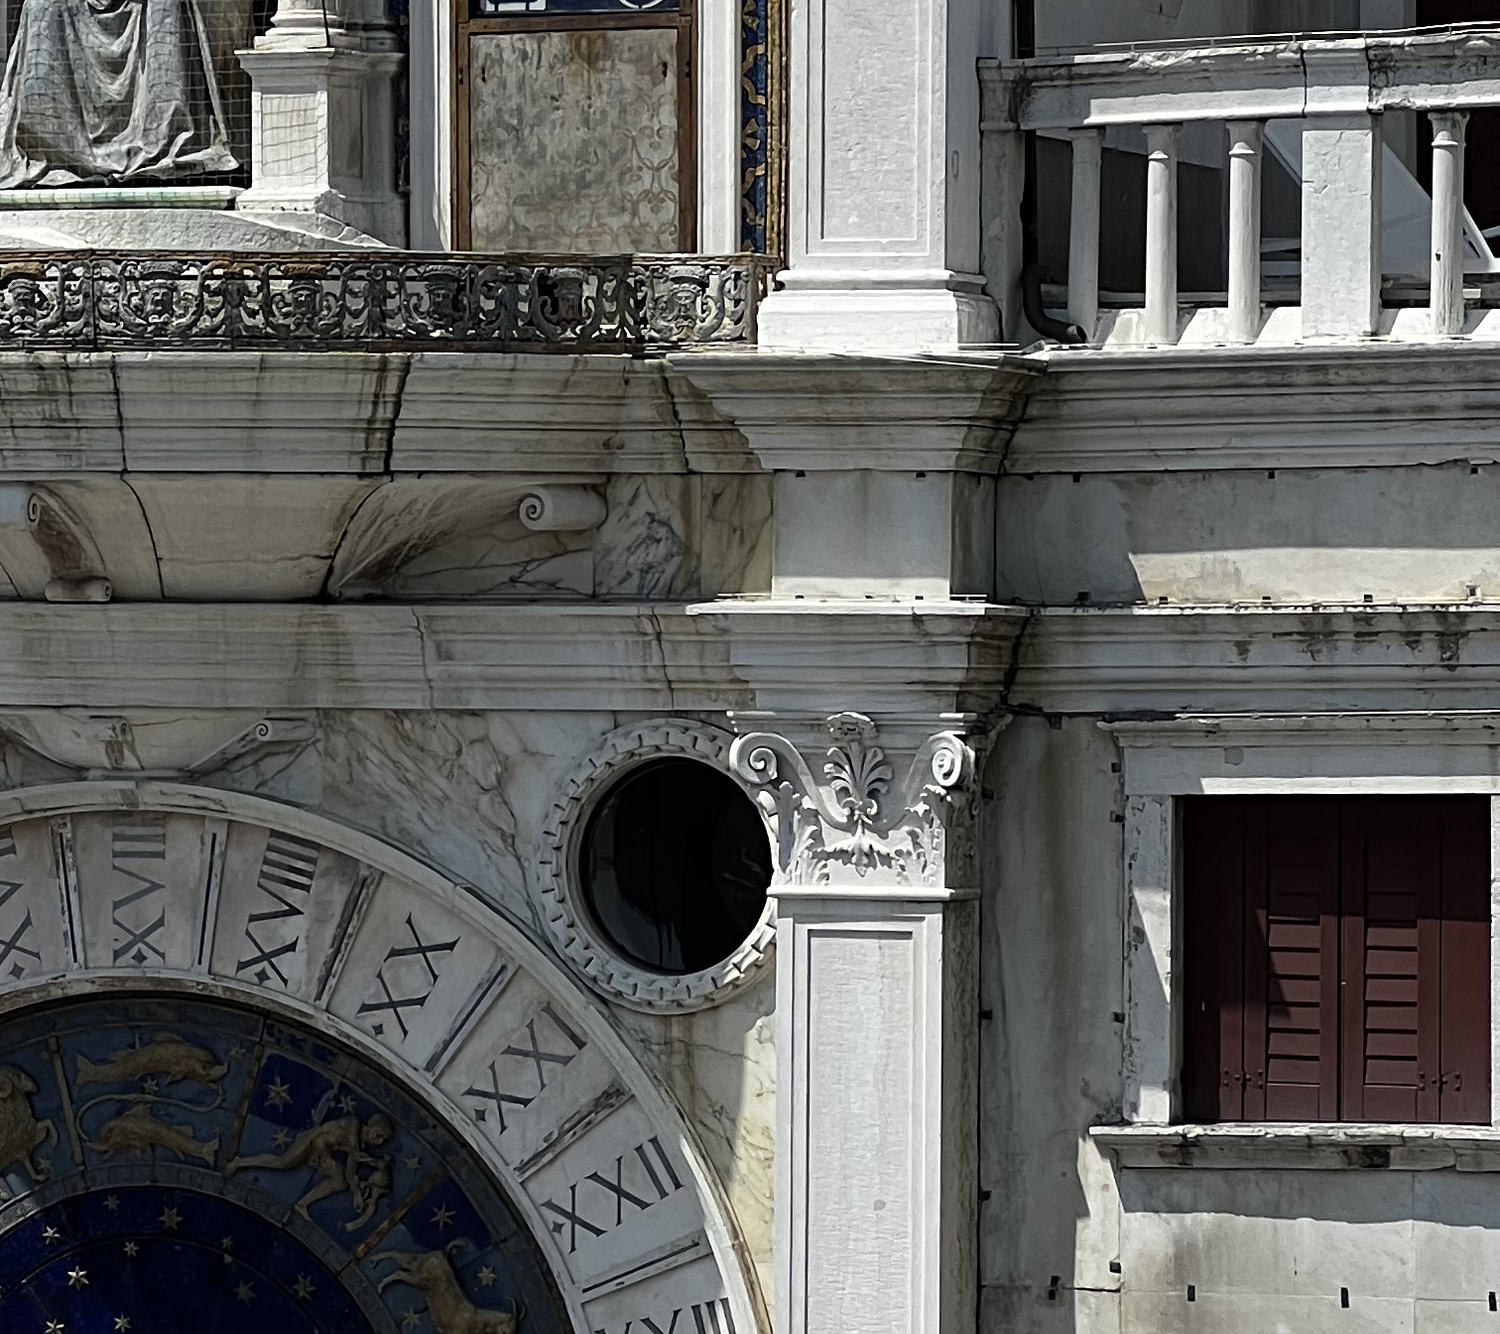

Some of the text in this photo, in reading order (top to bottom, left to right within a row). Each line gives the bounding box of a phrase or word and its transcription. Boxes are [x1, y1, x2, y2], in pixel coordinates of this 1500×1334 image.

[234, 829, 322, 988] XVIIII
[357, 912, 461, 1042] XX
[461, 1007, 588, 1135] XXI
[540, 1136, 686, 1254] XXII
